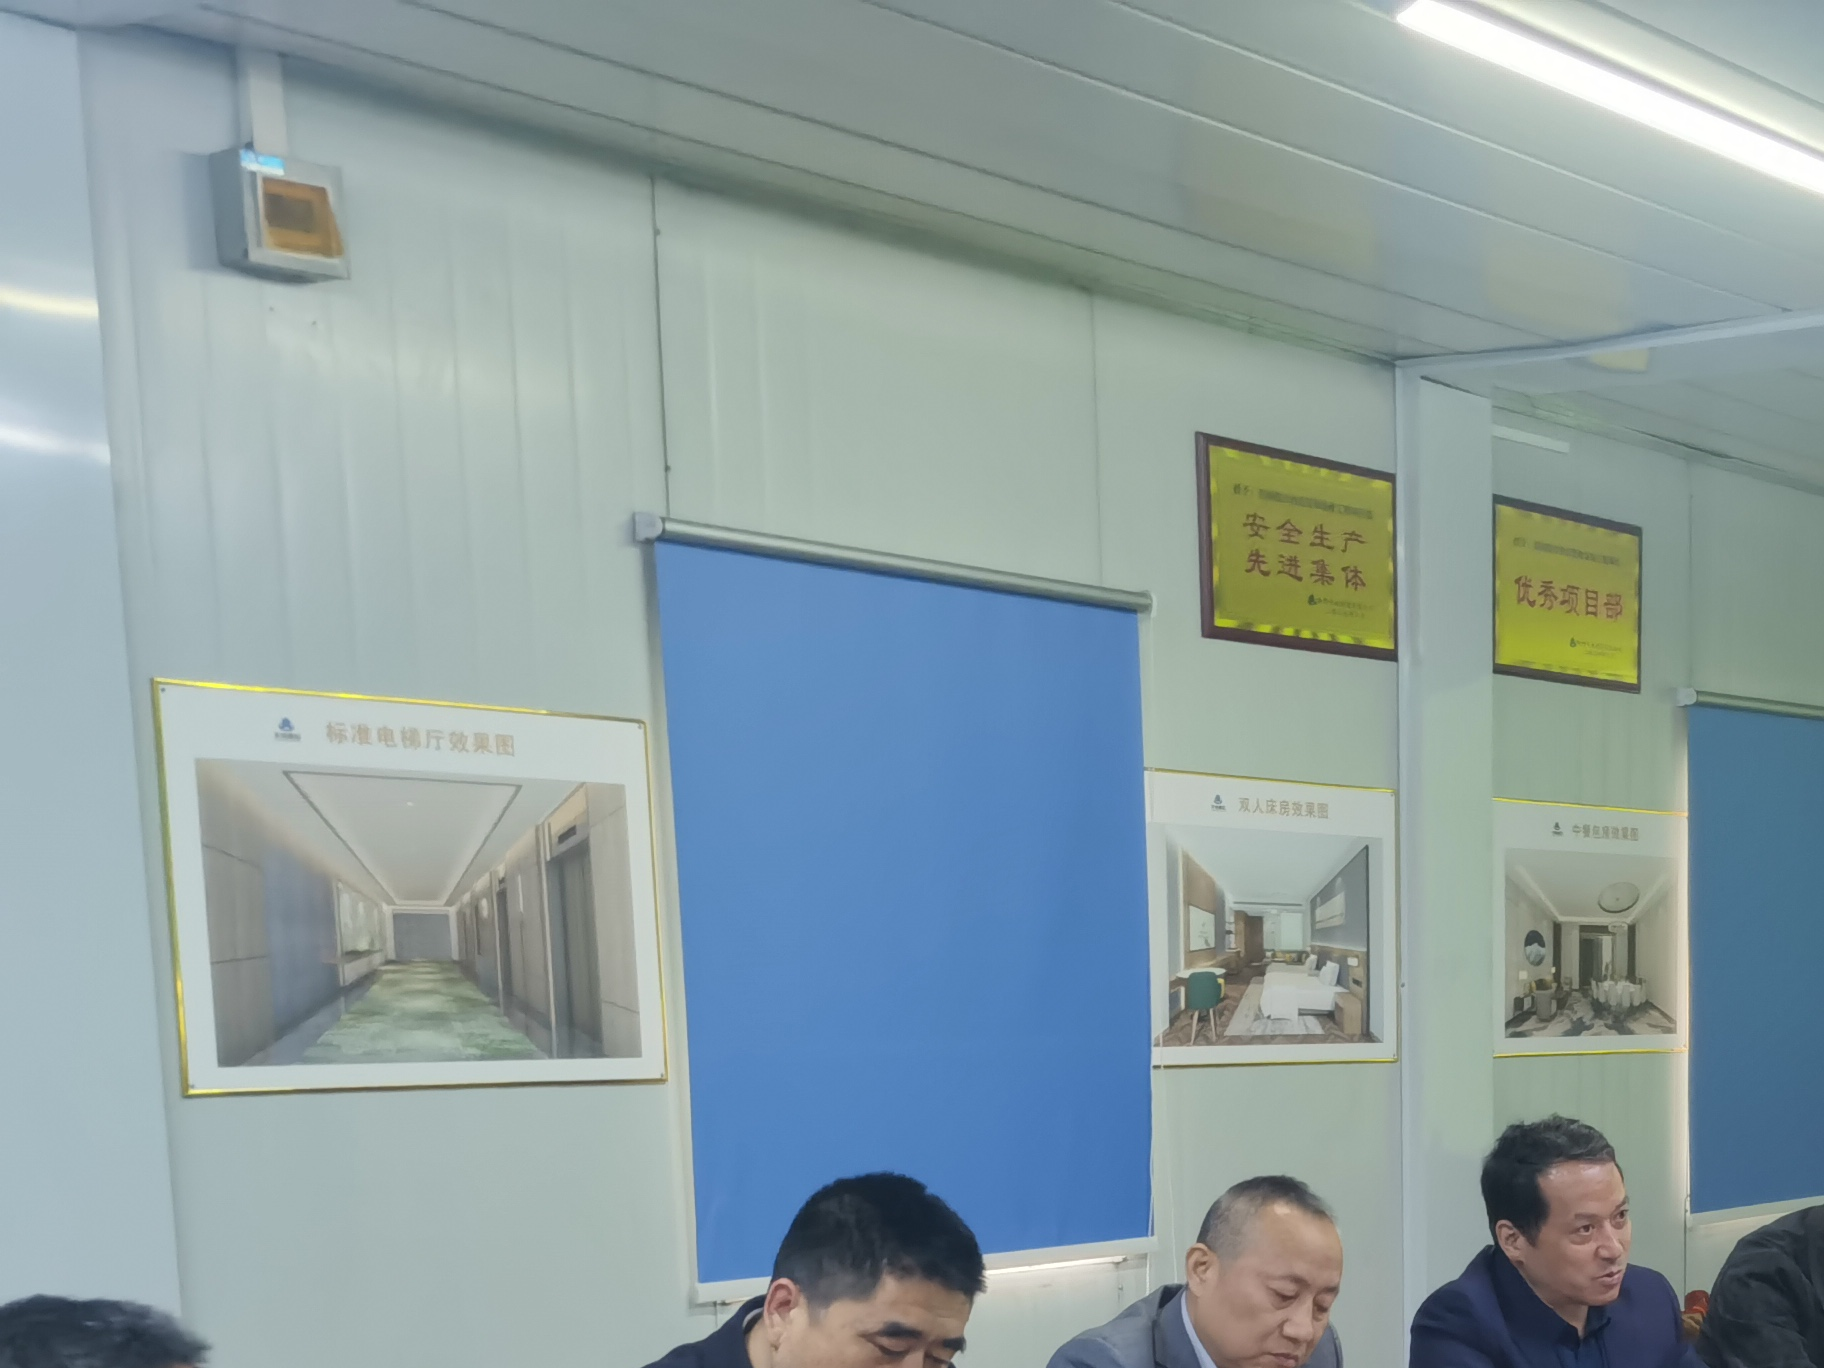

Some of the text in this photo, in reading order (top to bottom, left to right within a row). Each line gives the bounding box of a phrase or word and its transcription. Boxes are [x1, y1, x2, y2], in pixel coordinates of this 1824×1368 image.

[1242, 512, 1368, 553] 安全生产
[1244, 548, 1366, 592] 先进集体
[1513, 574, 1623, 622] 优秀项目部
[326, 721, 516, 758] 标准电梯厅效果图
[1238, 797, 1329, 820] 双人床房效果图
